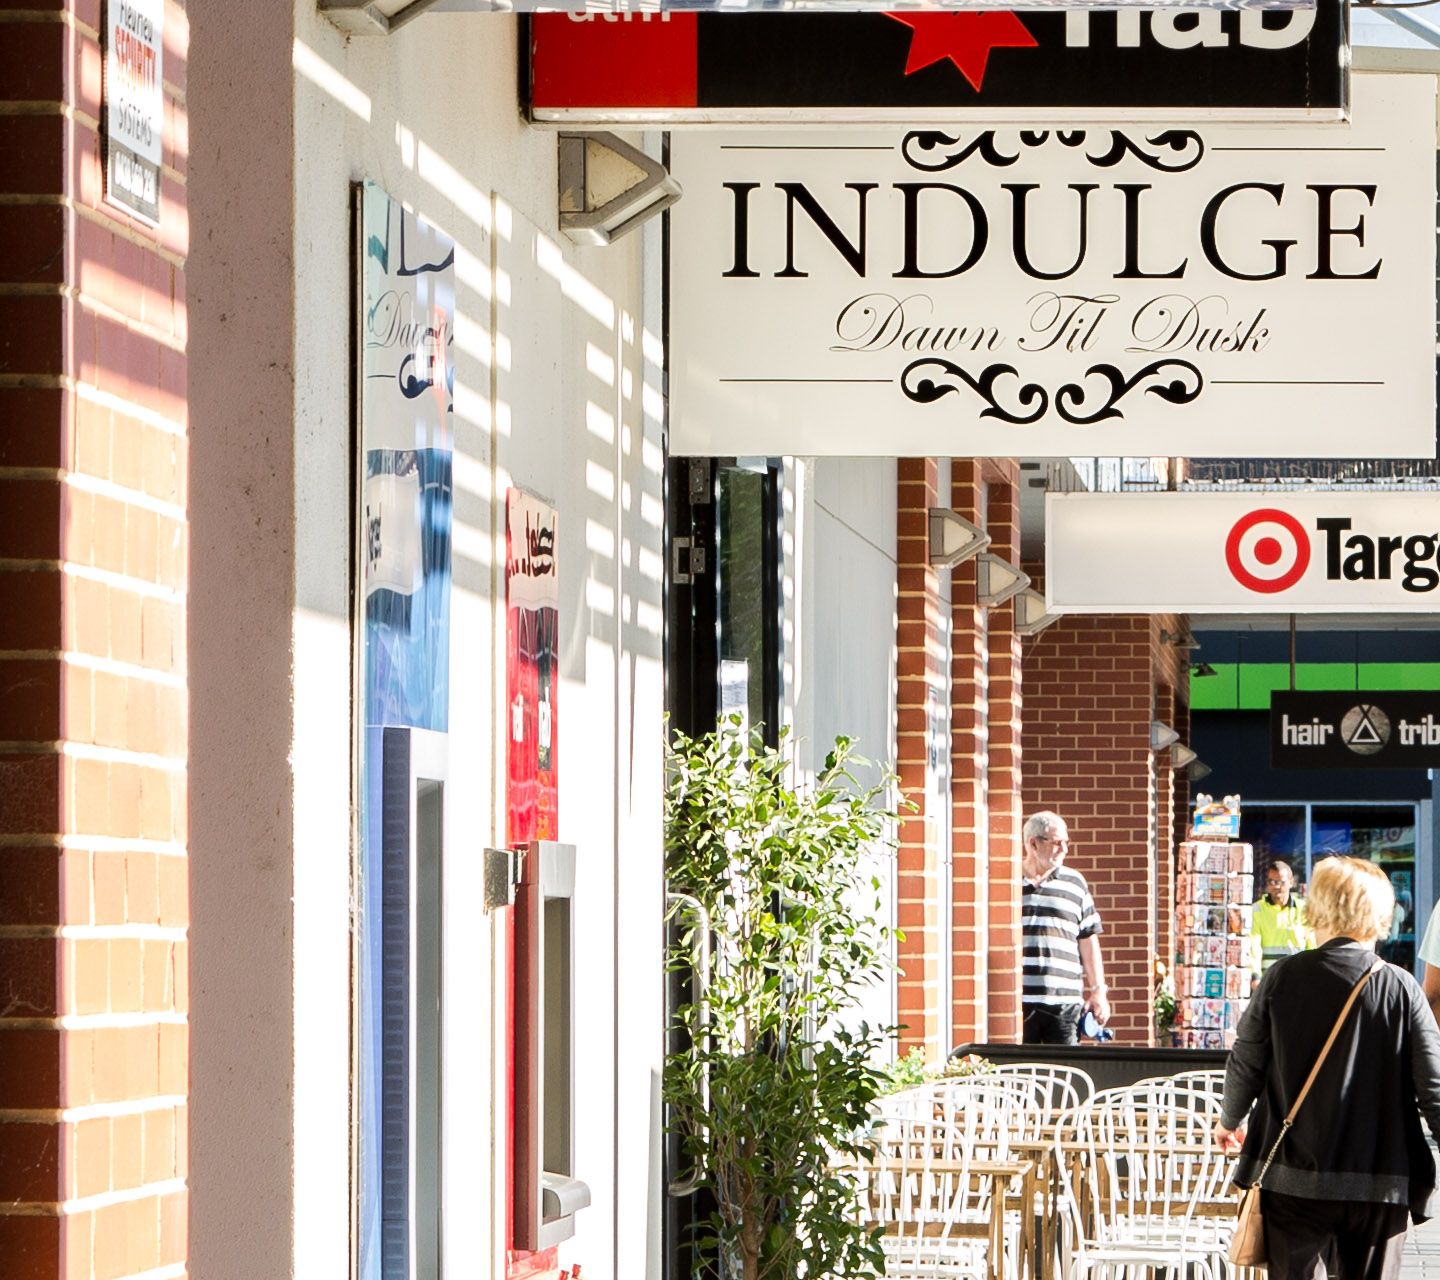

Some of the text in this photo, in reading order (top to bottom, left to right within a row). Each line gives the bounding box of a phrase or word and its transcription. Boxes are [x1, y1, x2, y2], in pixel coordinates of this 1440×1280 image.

[721, 181, 1384, 282] INDULGE
[829, 291, 1270, 354] Dawn Til Dusk
[1282, 714, 1334, 746] hair
